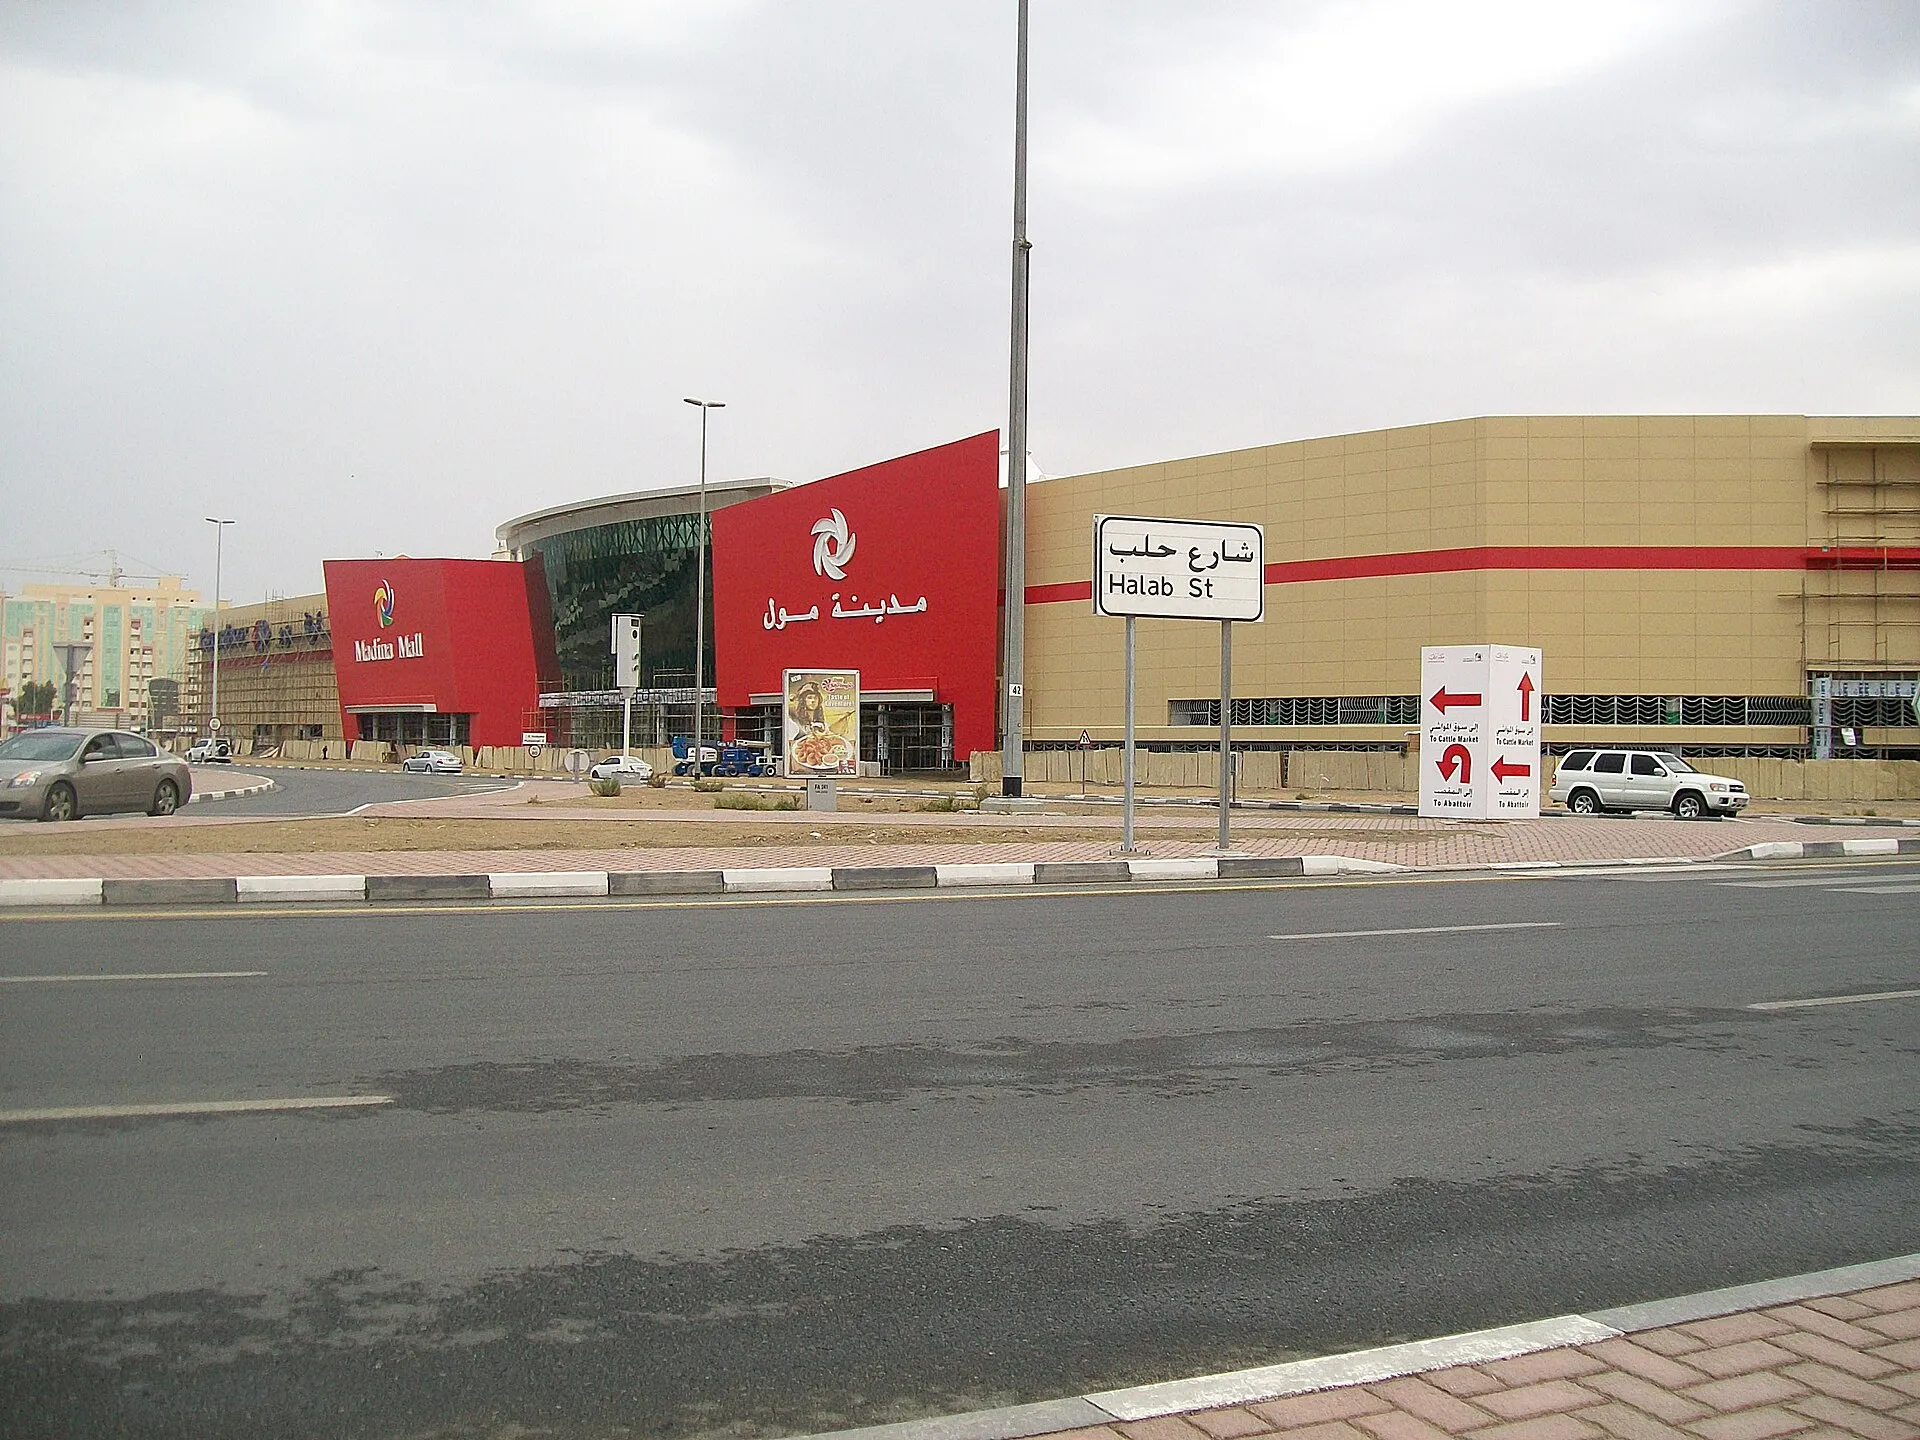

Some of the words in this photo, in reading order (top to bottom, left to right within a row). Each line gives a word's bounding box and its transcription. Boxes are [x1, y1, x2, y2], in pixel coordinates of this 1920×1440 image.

[1109, 534, 1177, 563] حلب
[1188, 539, 1254, 572] شارع
[1109, 573, 1174, 597] Halab
[1188, 577, 1214, 598] St
[763, 598, 820, 630] مول
[831, 593, 928, 624] مدينة
[354, 637, 395, 662] Madina
[397, 632, 424, 658] Mall
[1012, 685, 1021, 695] 42
[1453, 722, 1467, 732] سوق
[1469, 723, 1479, 733] إلى
[1496, 737, 1502, 745] To
[1463, 788, 1473, 798] إلى
[1433, 799, 1441, 807] To
[1443, 799, 1472, 808] Abattoir
